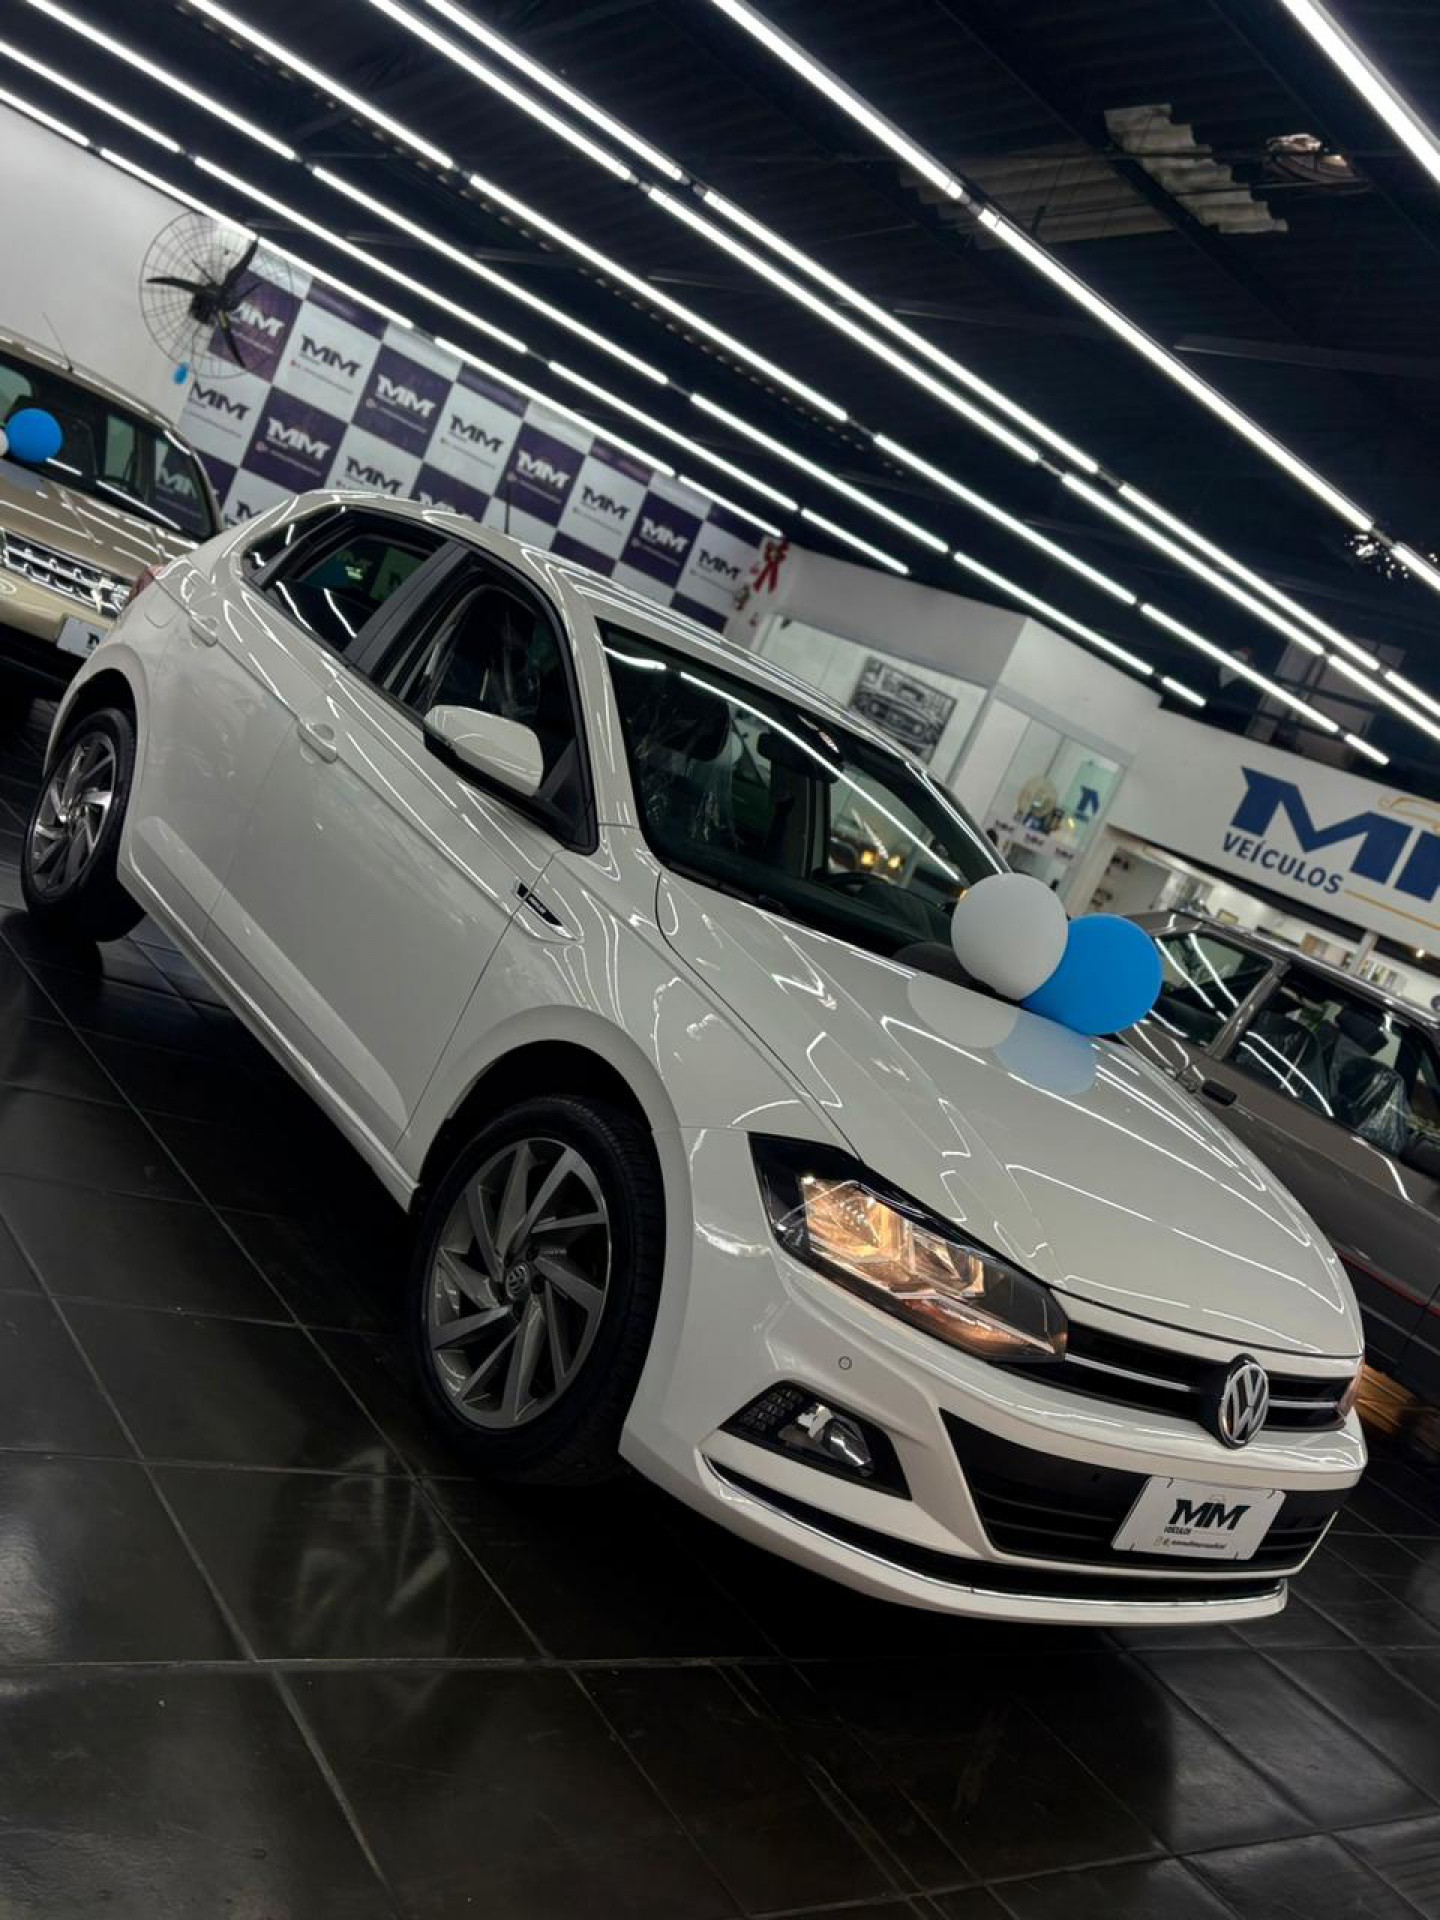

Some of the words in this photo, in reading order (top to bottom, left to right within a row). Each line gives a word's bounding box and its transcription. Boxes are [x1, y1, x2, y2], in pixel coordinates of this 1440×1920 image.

[302, 334, 362, 378] MM
[376, 374, 436, 418] MM
[267, 417, 330, 460] MM
[452, 414, 504, 453] MM
[347, 456, 403, 495] MM
[518, 450, 570, 489] MM
[582, 485, 630, 520] MM
[1221, 831, 1345, 896] VEÍCULOS
[1168, 1498, 1252, 1531] MM
